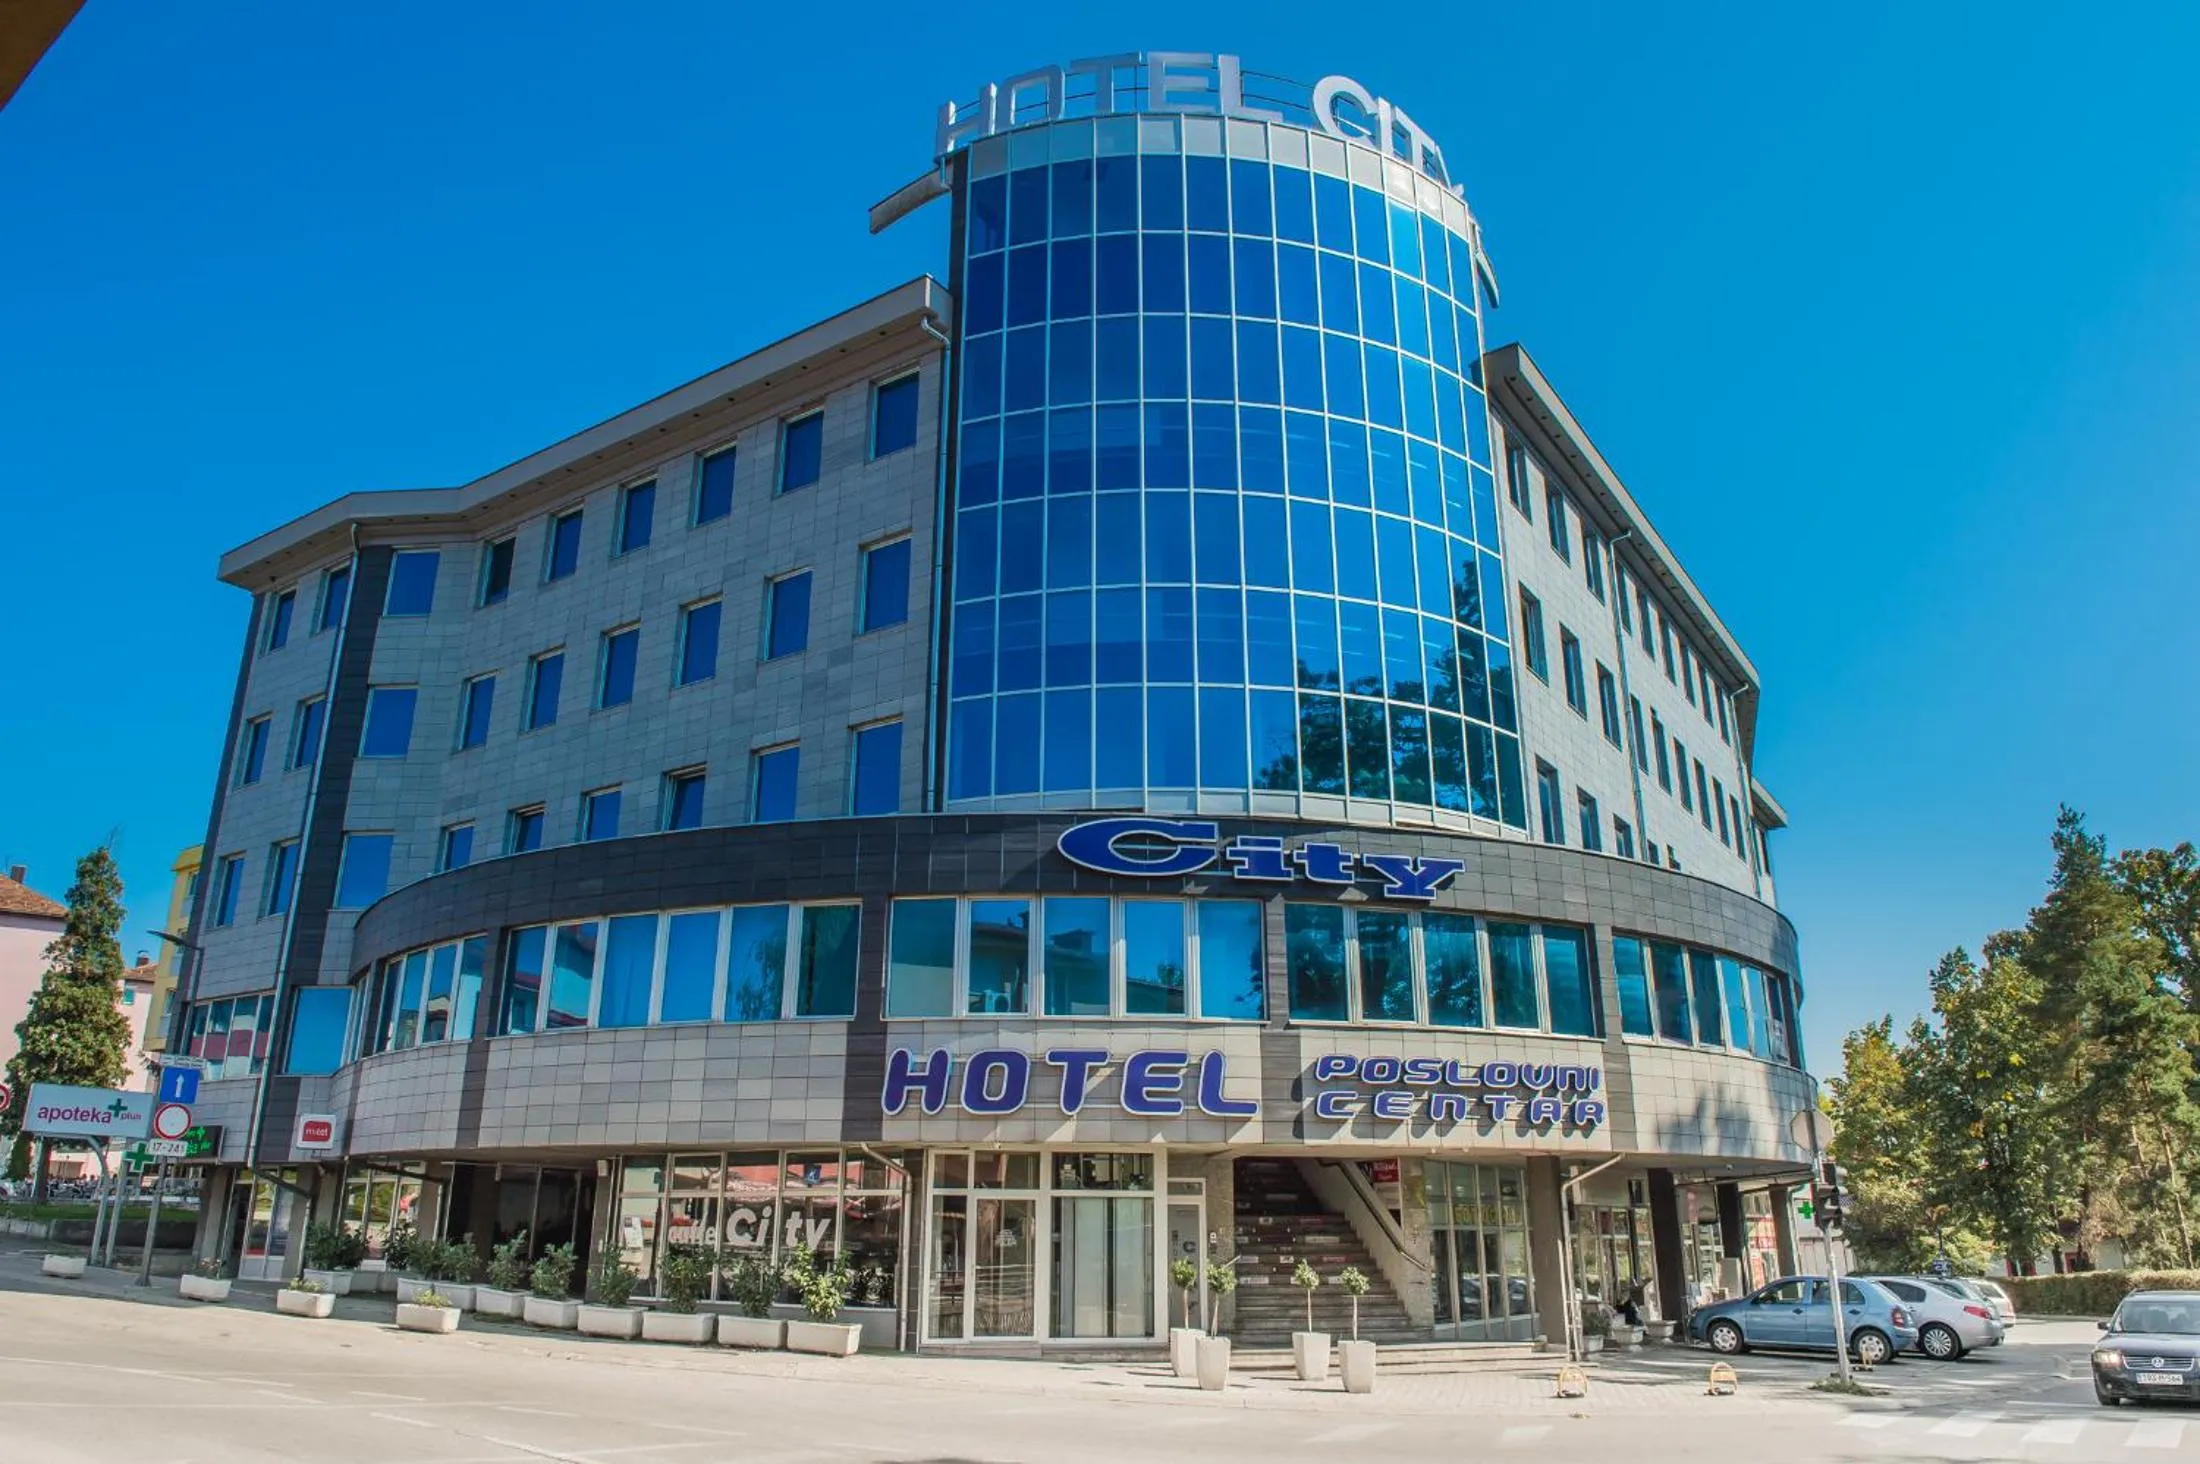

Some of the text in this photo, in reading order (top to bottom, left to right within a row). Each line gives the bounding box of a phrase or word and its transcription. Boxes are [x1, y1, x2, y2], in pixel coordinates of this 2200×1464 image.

[935, 51, 1284, 154] HOTEL
[1057, 816, 1466, 900] City
[881, 1047, 1260, 1116] HOTEL
[1315, 1054, 1601, 1092] POSLOVNI
[37, 1105, 142, 1123] apoteka plus
[1315, 1090, 1606, 1125] CENTAR
[726, 1205, 832, 1251] City
